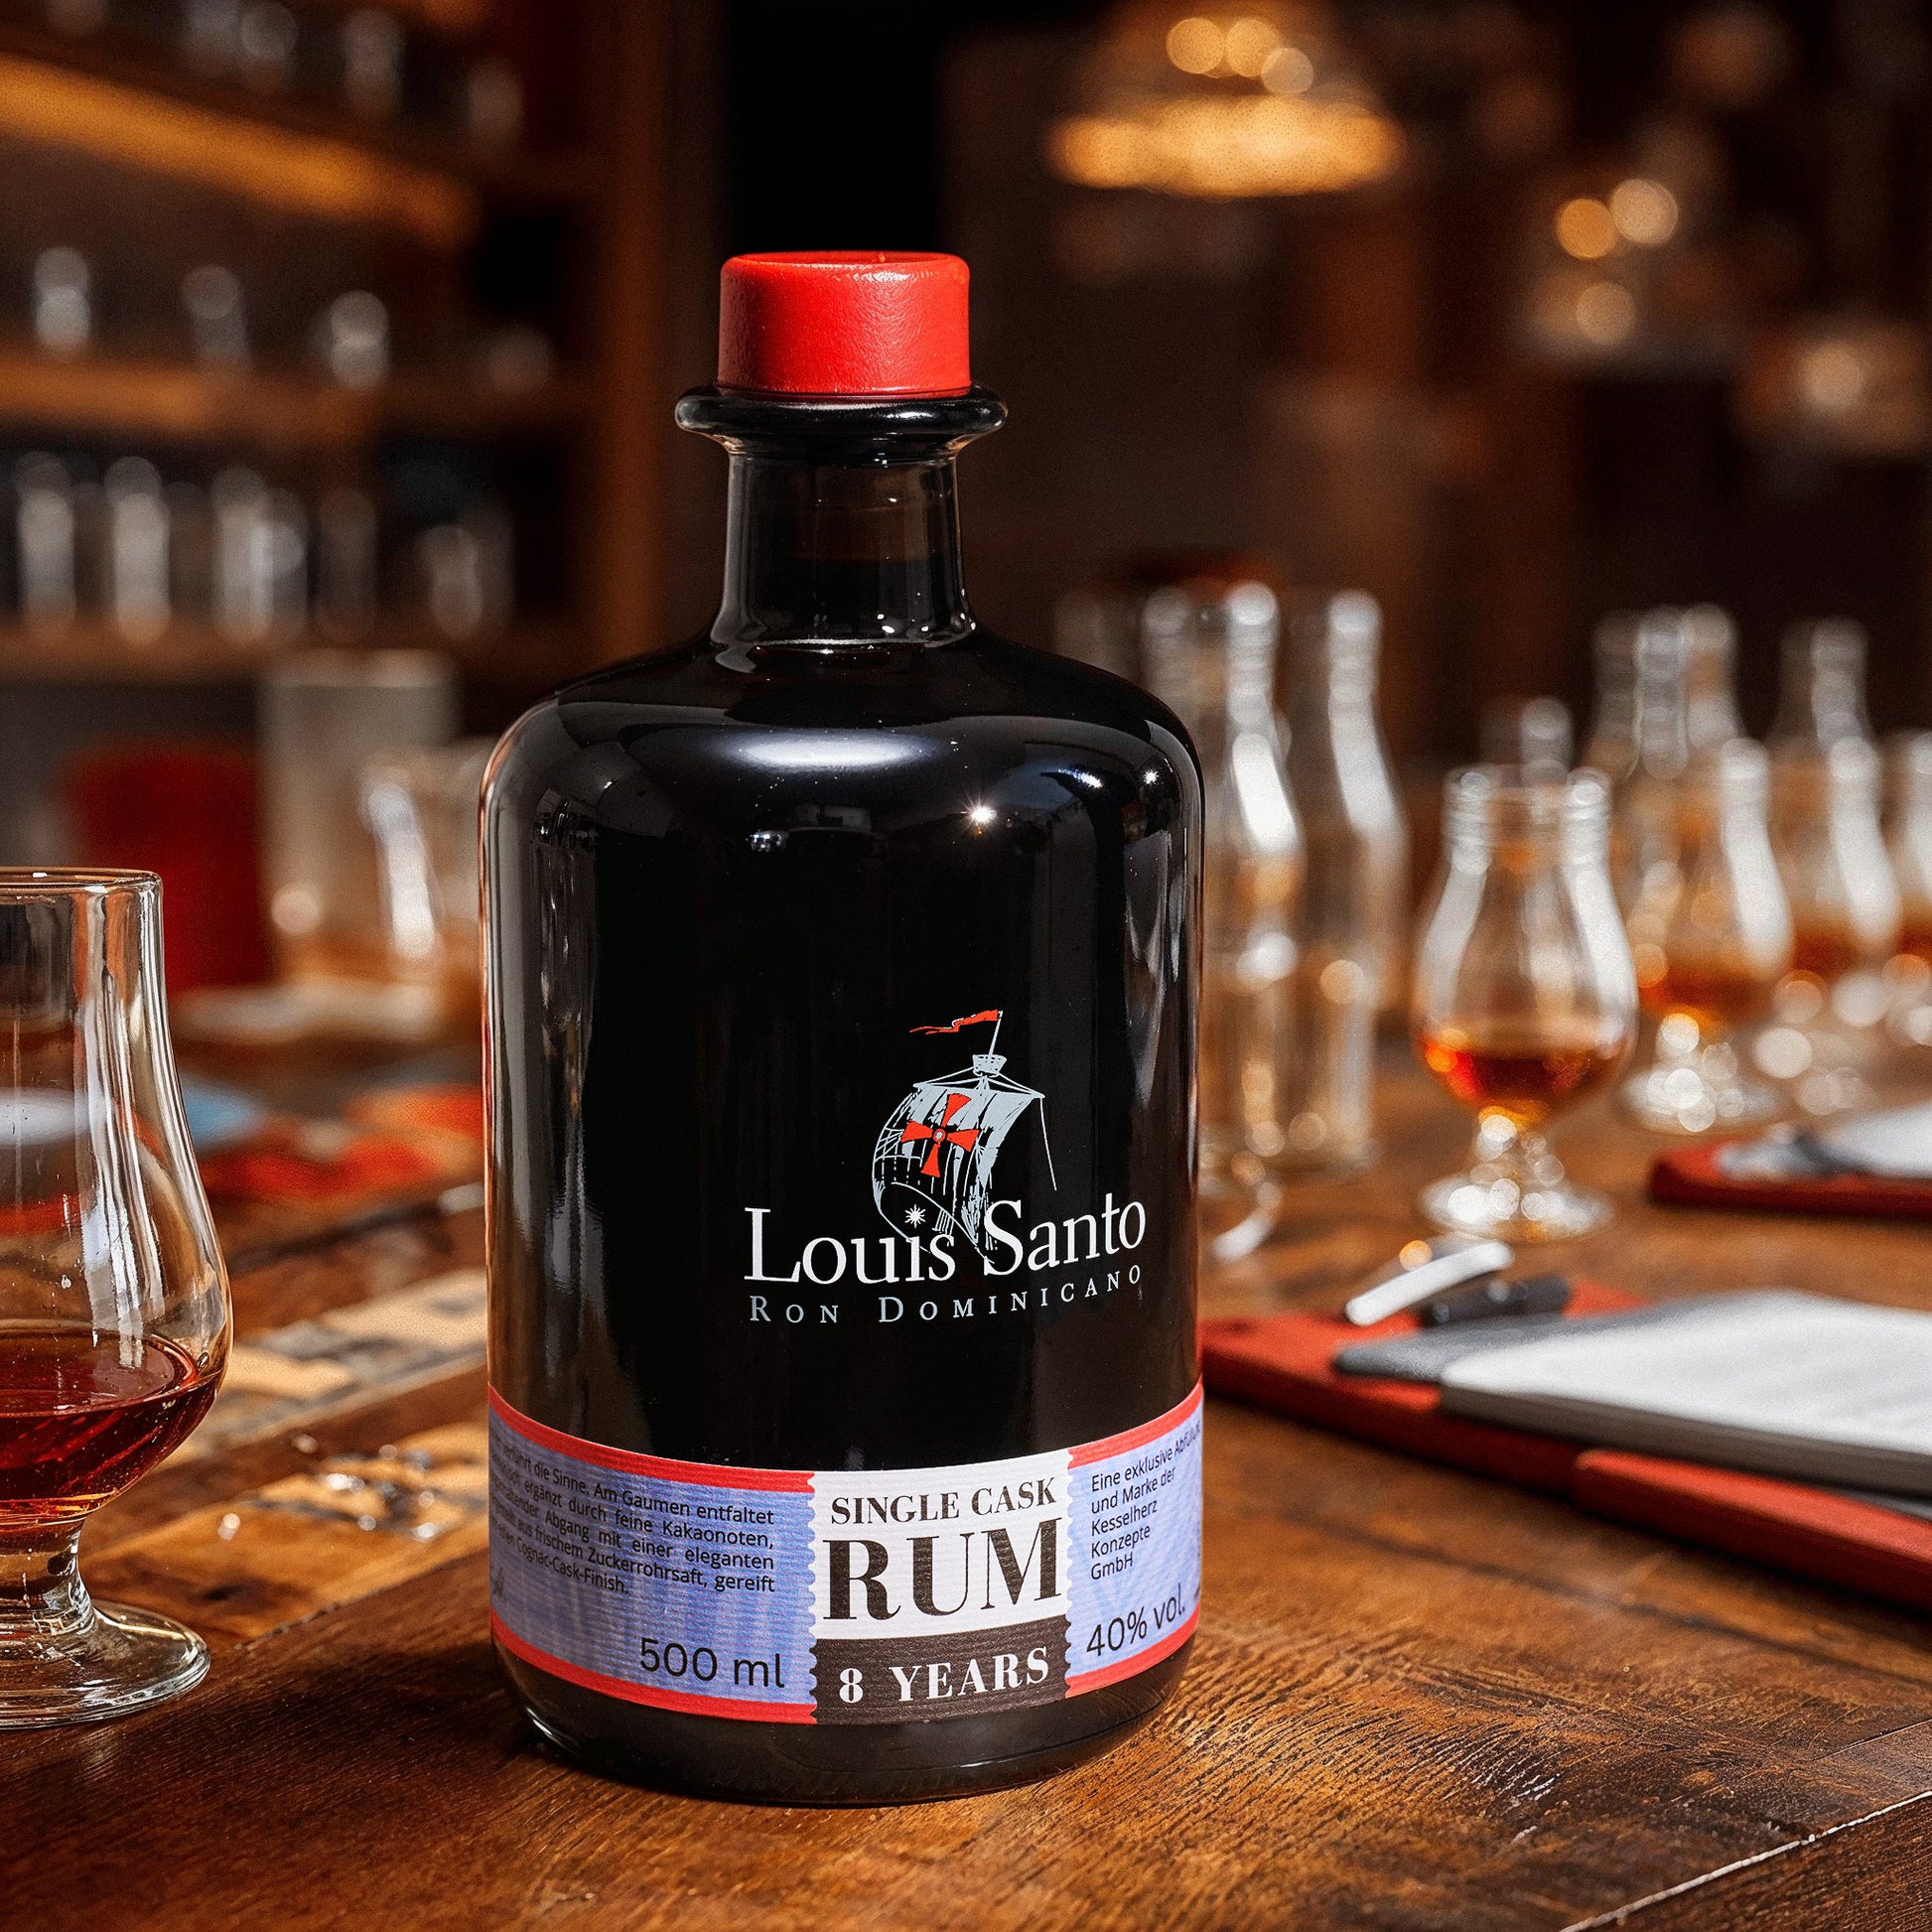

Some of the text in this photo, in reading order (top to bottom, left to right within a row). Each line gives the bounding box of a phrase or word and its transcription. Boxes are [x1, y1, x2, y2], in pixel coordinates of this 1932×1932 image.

[744, 1191, 1147, 1286] Louis Santo
[534, 1461, 550, 1481] die
[553, 1468, 590, 1496] Sinne.
[594, 1482, 617, 1503] Am
[621, 1489, 690, 1518] Gaumen
[696, 1504, 775, 1526] entfaltet
[1091, 1472, 1121, 1493] Eine
[1125, 1447, 1173, 1481] exklusive
[1091, 1466, 1175, 1515] und Marke der
[524, 1479, 774, 1550] ergänzt durch feine Kakaonoten,
[830, 1476, 1057, 1526] SINGLE CASK
[1091, 1499, 1158, 1537] Kesselherz
[535, 1525, 584, 1560] frischem
[588, 1546, 708, 1588] Zuckerrohrsaft,
[714, 1575, 775, 1592] gereift
[545, 1509, 590, 1544] Abgang
[599, 1530, 622, 1549] mit
[631, 1538, 674, 1559] einer
[684, 1546, 774, 1570] eleganten
[822, 1516, 1063, 1622] RUM
[1090, 1551, 1133, 1581] GmbH
[1091, 1525, 1152, 1560] Konzepte
[1086, 1582, 1185, 1657] 40% vol.
[639, 1637, 785, 1689] 500 ml
[839, 1645, 1050, 1704] 8 YEARS
